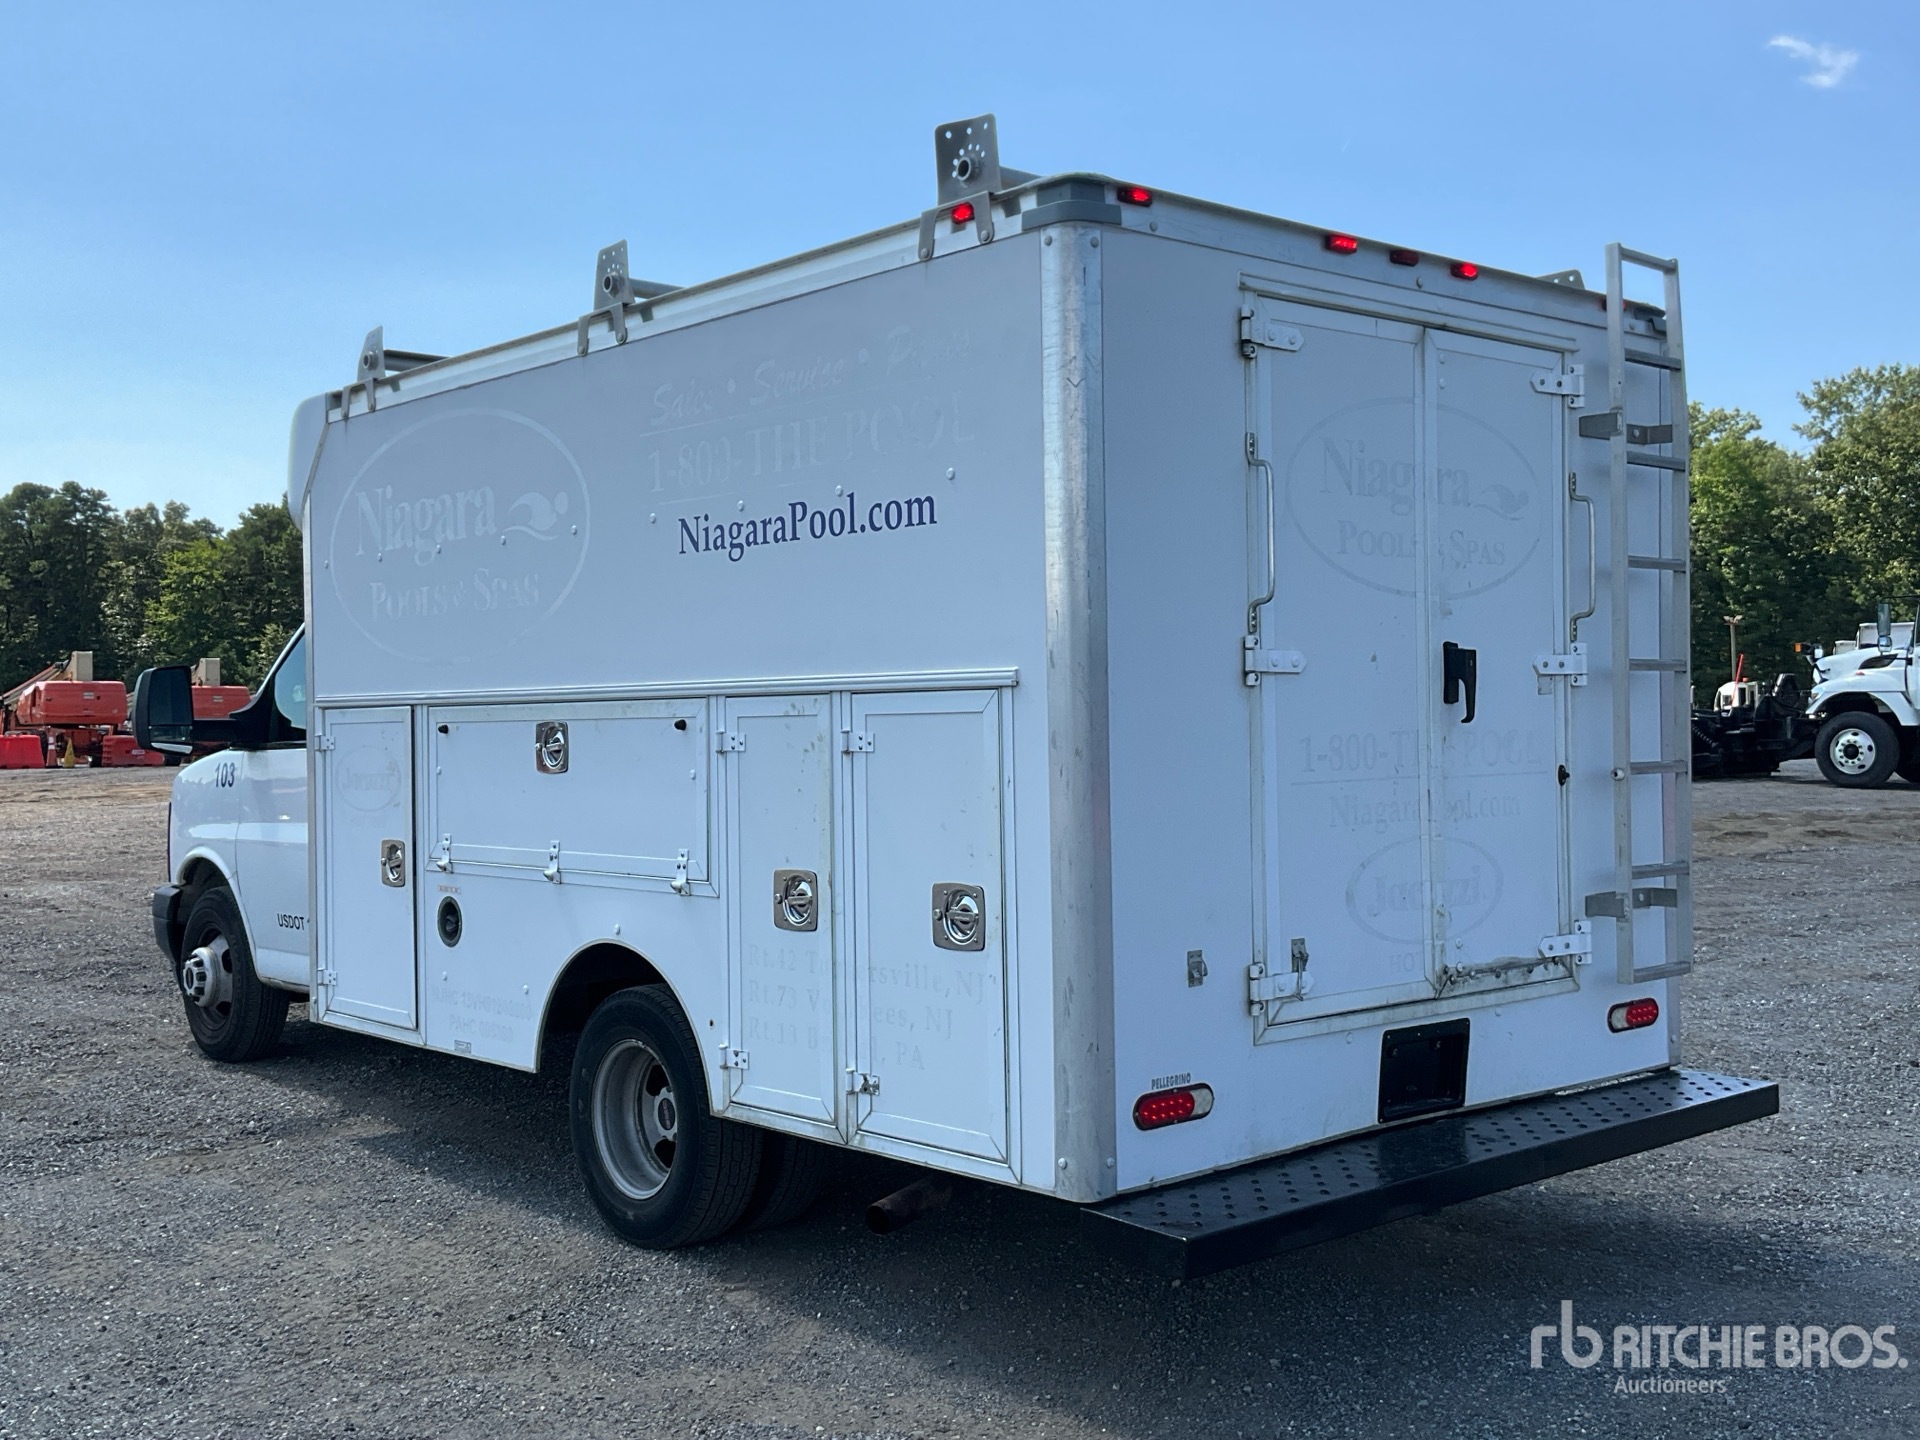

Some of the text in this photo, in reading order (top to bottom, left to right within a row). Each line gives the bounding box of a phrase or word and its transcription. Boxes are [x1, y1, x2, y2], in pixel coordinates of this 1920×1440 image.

[1319, 436, 1472, 517] Niagra
[354, 485, 498, 566] Niagara
[677, 492, 938, 563] NiagaraPool.com
[1299, 729, 1455, 773] 1-800-T
[214, 762, 236, 788] 103
[277, 912, 305, 931] USDOT
[1151, 1072, 1192, 1090] PELLEGRINO
